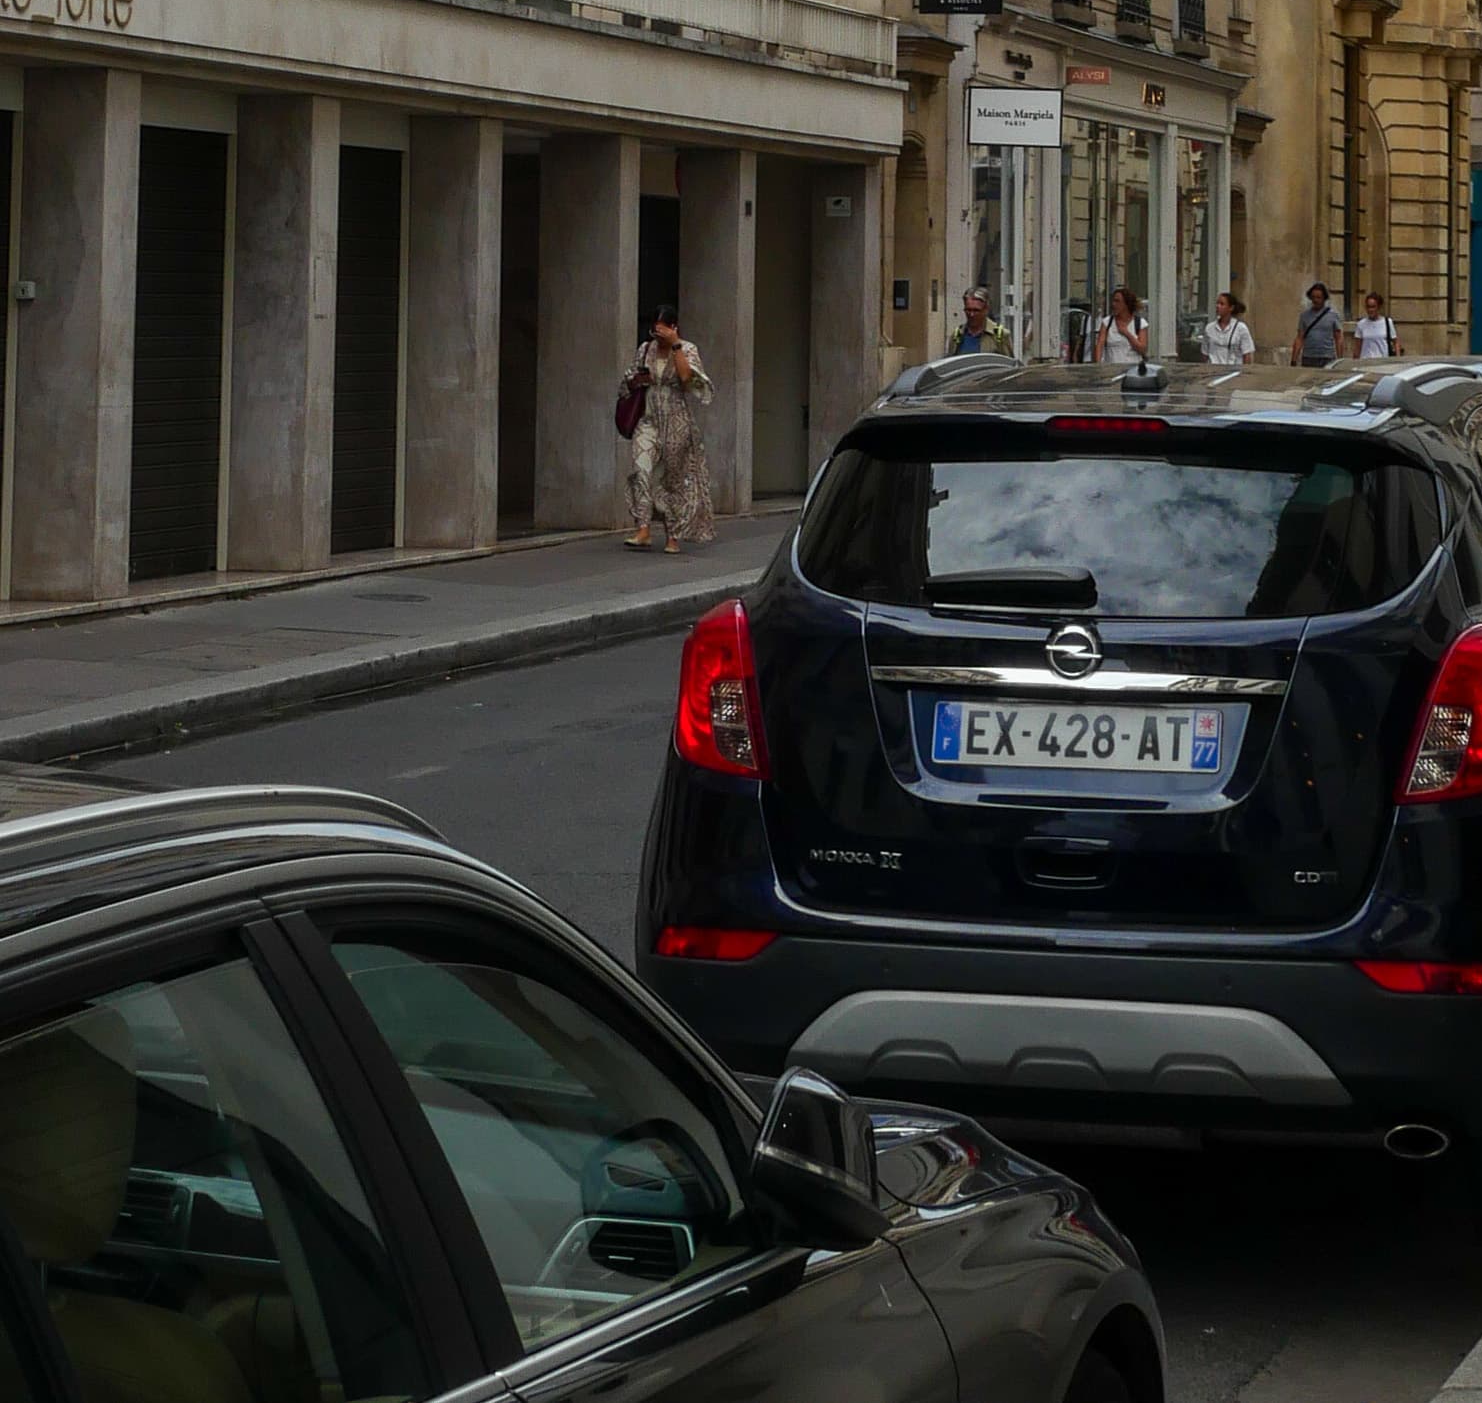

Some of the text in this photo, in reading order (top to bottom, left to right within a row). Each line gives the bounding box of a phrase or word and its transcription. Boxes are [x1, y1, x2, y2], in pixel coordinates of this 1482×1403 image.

[1072, 71, 1105, 80] ALYSI
[977, 107, 1054, 121] Maison Margiela
[942, 738, 951, 750] F
[965, 710, 1189, 762] EX-428-AT
[1194, 741, 1215, 763] 77
[810, 849, 902, 869] MOKKA X
